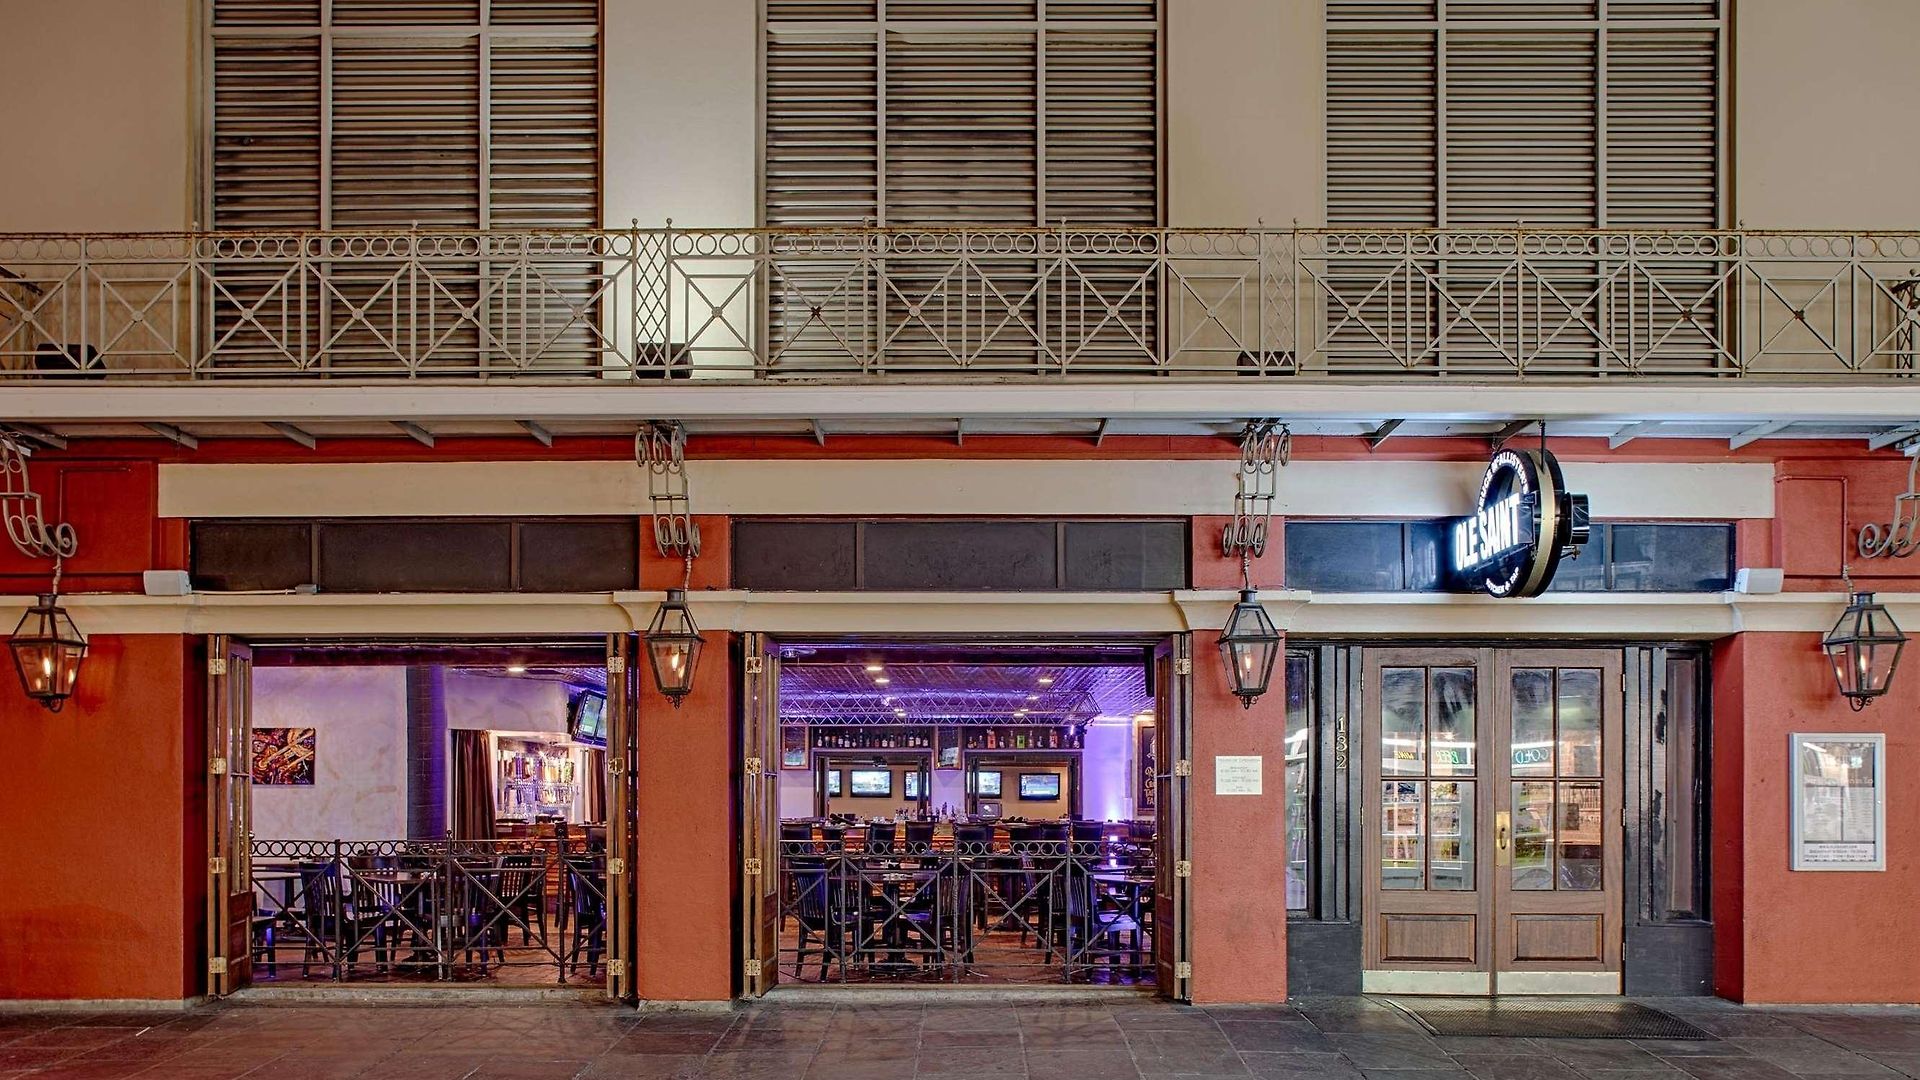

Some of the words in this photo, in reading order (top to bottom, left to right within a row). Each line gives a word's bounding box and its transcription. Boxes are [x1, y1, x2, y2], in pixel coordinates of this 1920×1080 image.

[1456, 516, 1479, 571] OLE
[1478, 492, 1521, 560] SAINT
[1335, 716, 1348, 769] 132
